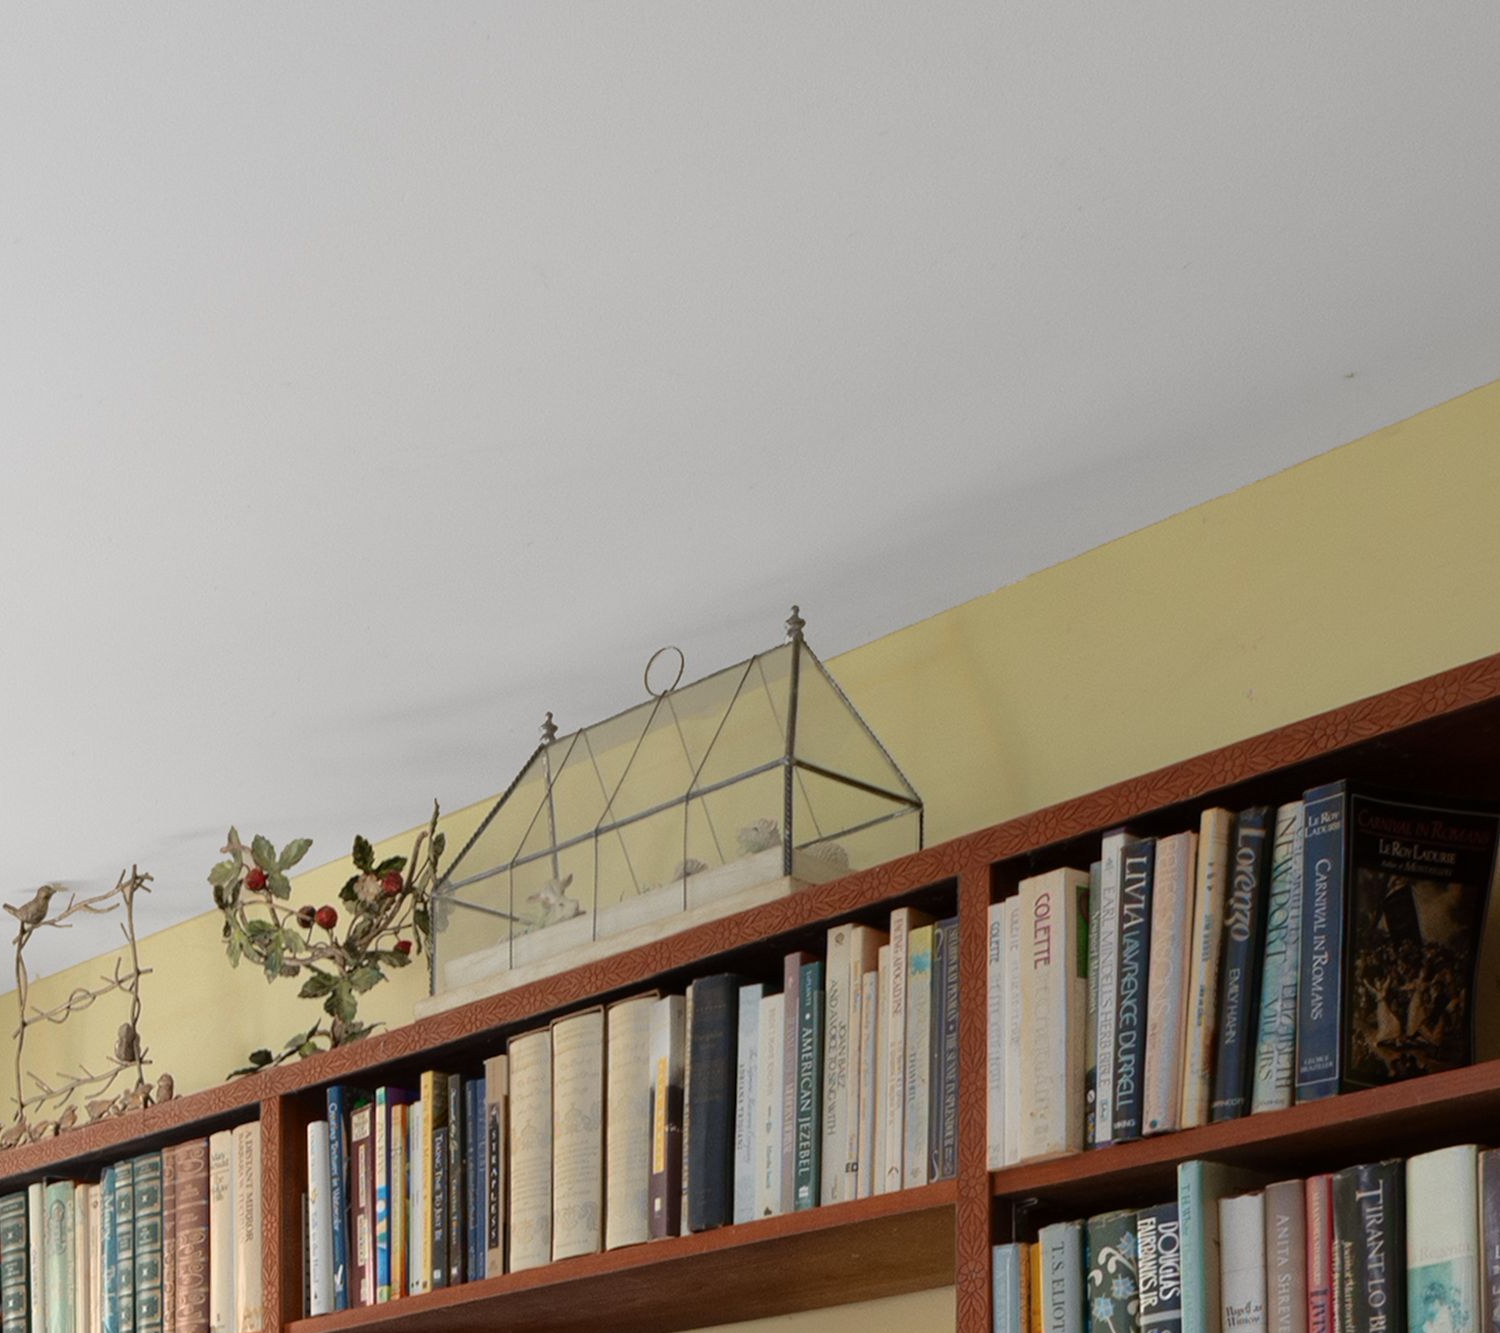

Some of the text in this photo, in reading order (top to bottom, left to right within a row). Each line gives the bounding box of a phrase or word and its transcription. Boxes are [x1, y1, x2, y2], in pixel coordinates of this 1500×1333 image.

[1101, 886, 1116, 922] EARL
[1224, 827, 1267, 941] Lorenzo
[1265, 816, 1297, 963] NEWPORT
[989, 921, 1000, 966] COLETTE
[1034, 893, 1051, 970] COLETTE
[1310, 859, 1332, 1020] CARNIVAL IN ROMANS
[1116, 856, 1147, 1111] LIVIA LAWRENCE DURRELL
[1098, 1051, 1112, 1087] BIBLE
[1099, 1012, 1113, 1049] HERB
[245, 1140, 255, 1187] DISTANT
[490, 1130, 498, 1238] STRAPLESS
[245, 1191, 255, 1243] MIRROR
[1354, 1179, 1386, 1274] TIRANT
[1157, 1220, 1180, 1300] DOUGLAS
[1275, 1214, 1292, 1333] ANITA SHREVE
[1368, 1277, 1386, 1308] LO
